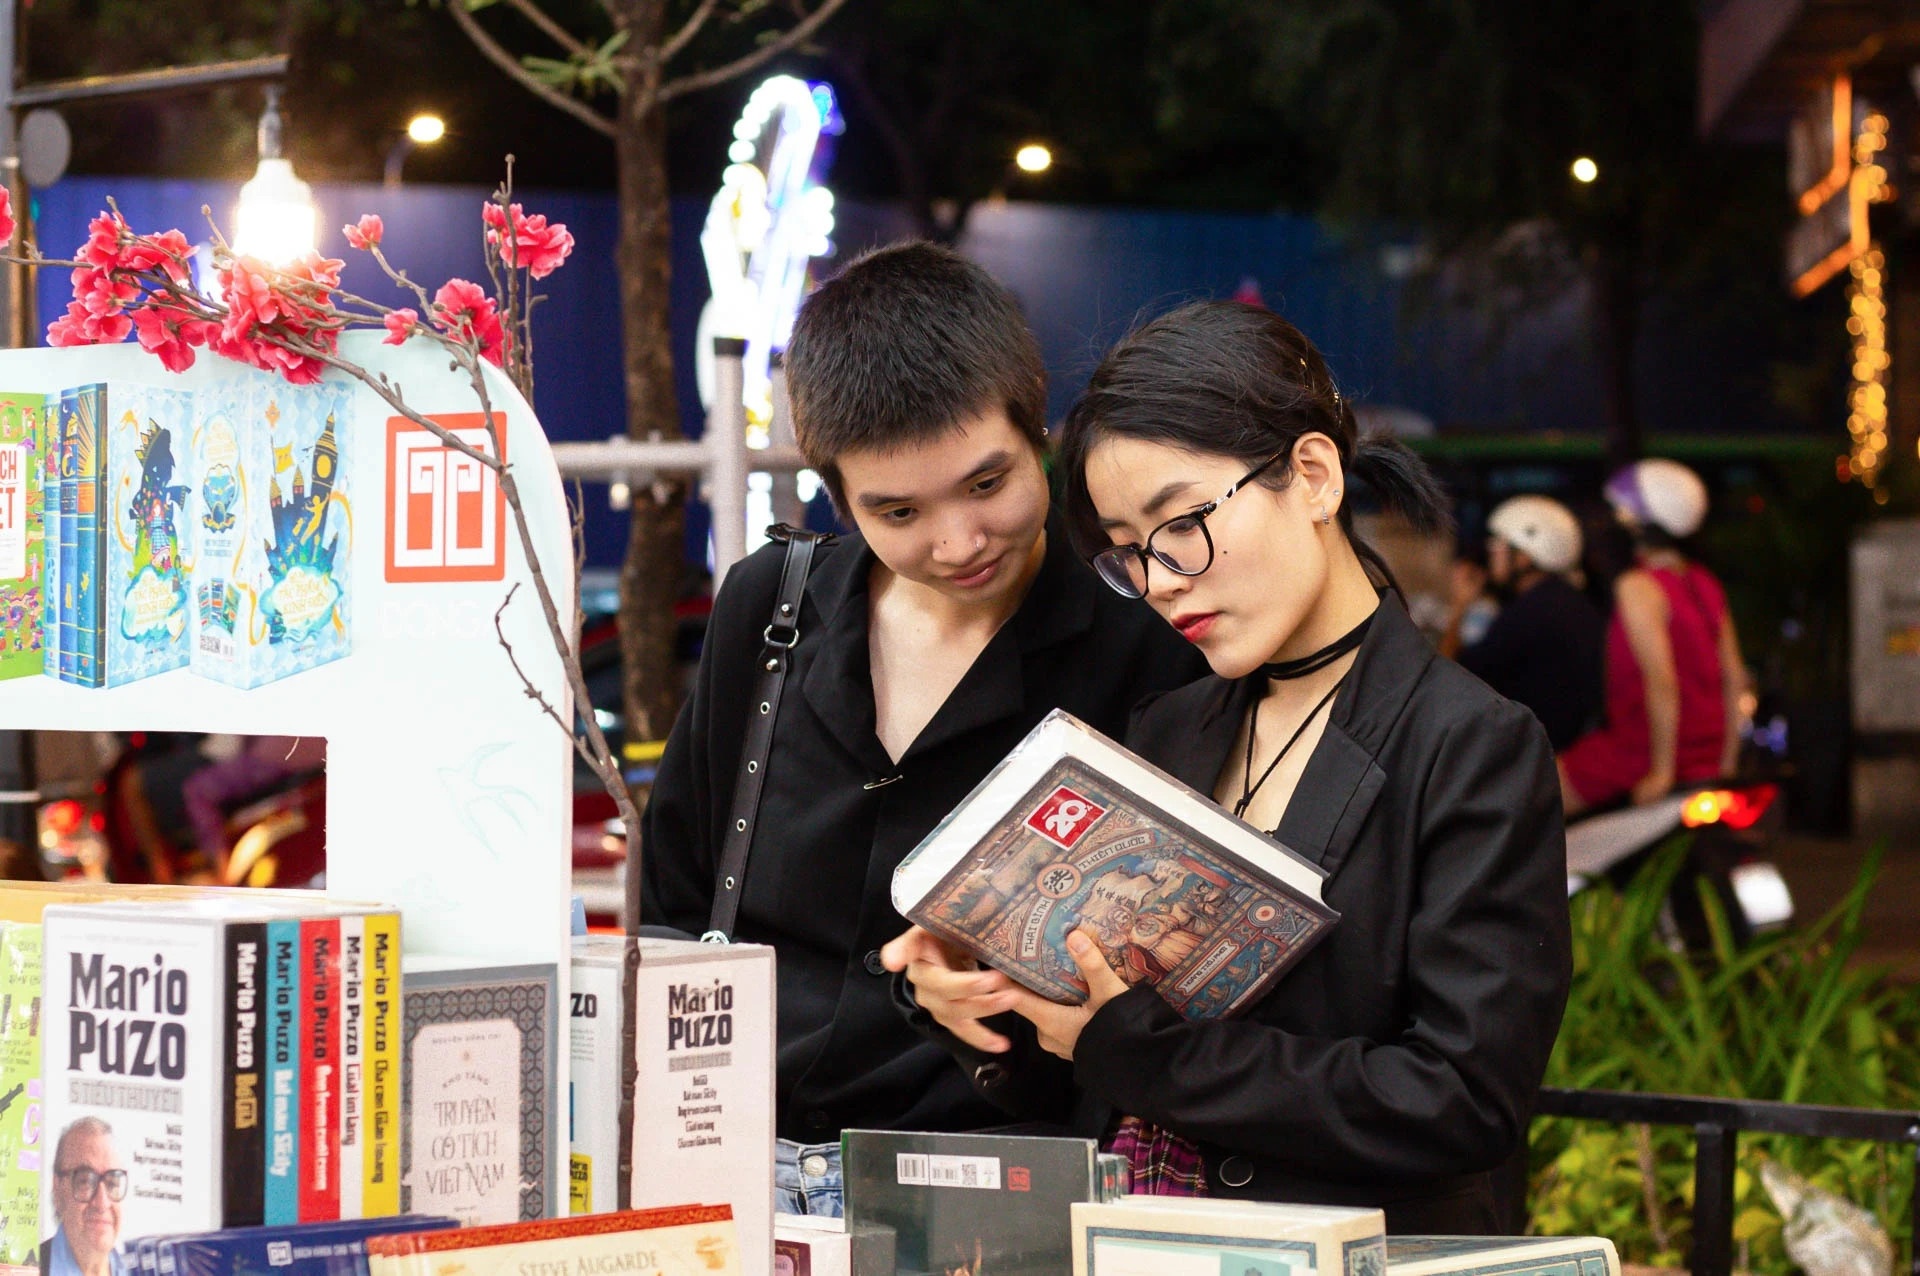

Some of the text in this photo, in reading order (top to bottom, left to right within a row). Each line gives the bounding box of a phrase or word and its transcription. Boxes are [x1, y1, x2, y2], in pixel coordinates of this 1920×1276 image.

[68, 952, 188, 1016] Mario
[236, 942, 257, 1010] Mario
[275, 942, 292, 1005] Mario
[314, 938, 330, 1000] Mario
[346, 936, 360, 998] Mario
[374, 933, 388, 995] Mario
[668, 978, 733, 1015] Mario
[67, 1012, 186, 1080] Puzo
[236, 1011, 256, 1068] Puzo
[275, 1010, 292, 1063] Puzo
[314, 1006, 330, 1059] Puzo
[346, 1004, 360, 1056] Puzo
[375, 1001, 388, 1052] Puzo
[667, 1013, 732, 1051] Puzo
[518, 1250, 658, 1276] STEVE AUGARDE
